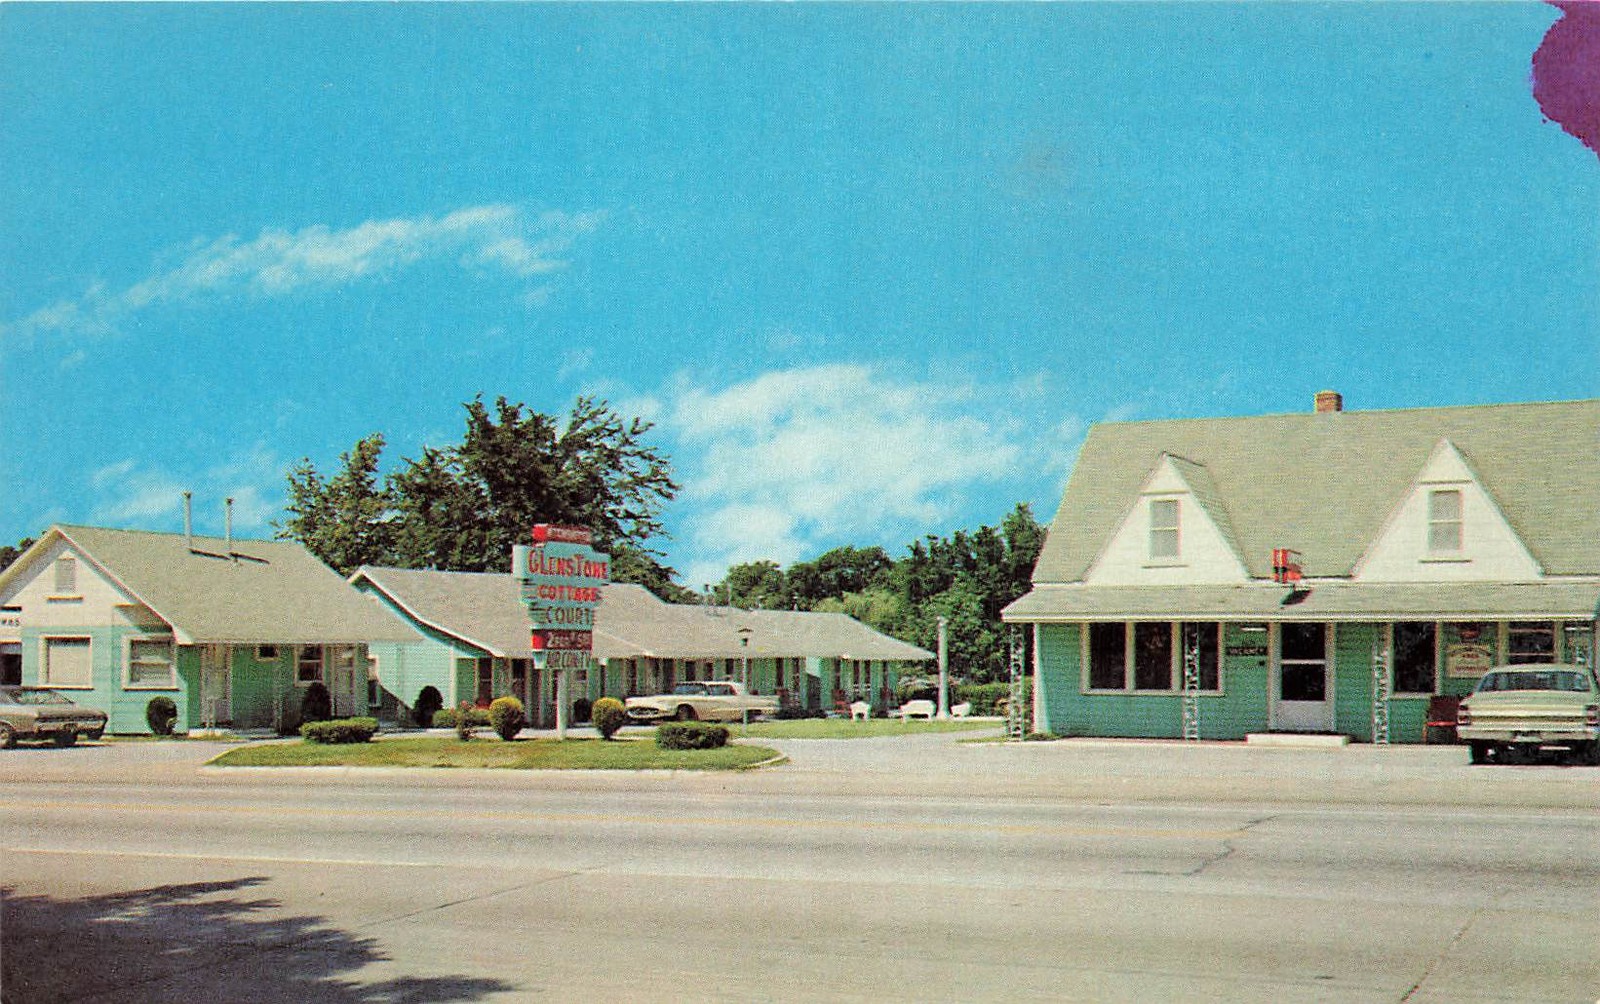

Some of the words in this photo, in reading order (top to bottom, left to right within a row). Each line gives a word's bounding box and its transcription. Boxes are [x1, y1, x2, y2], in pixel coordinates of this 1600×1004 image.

[528, 549, 608, 580] GLENSTONE
[537, 585, 599, 603] COTTAGE
[546, 606, 590, 625] COURT
